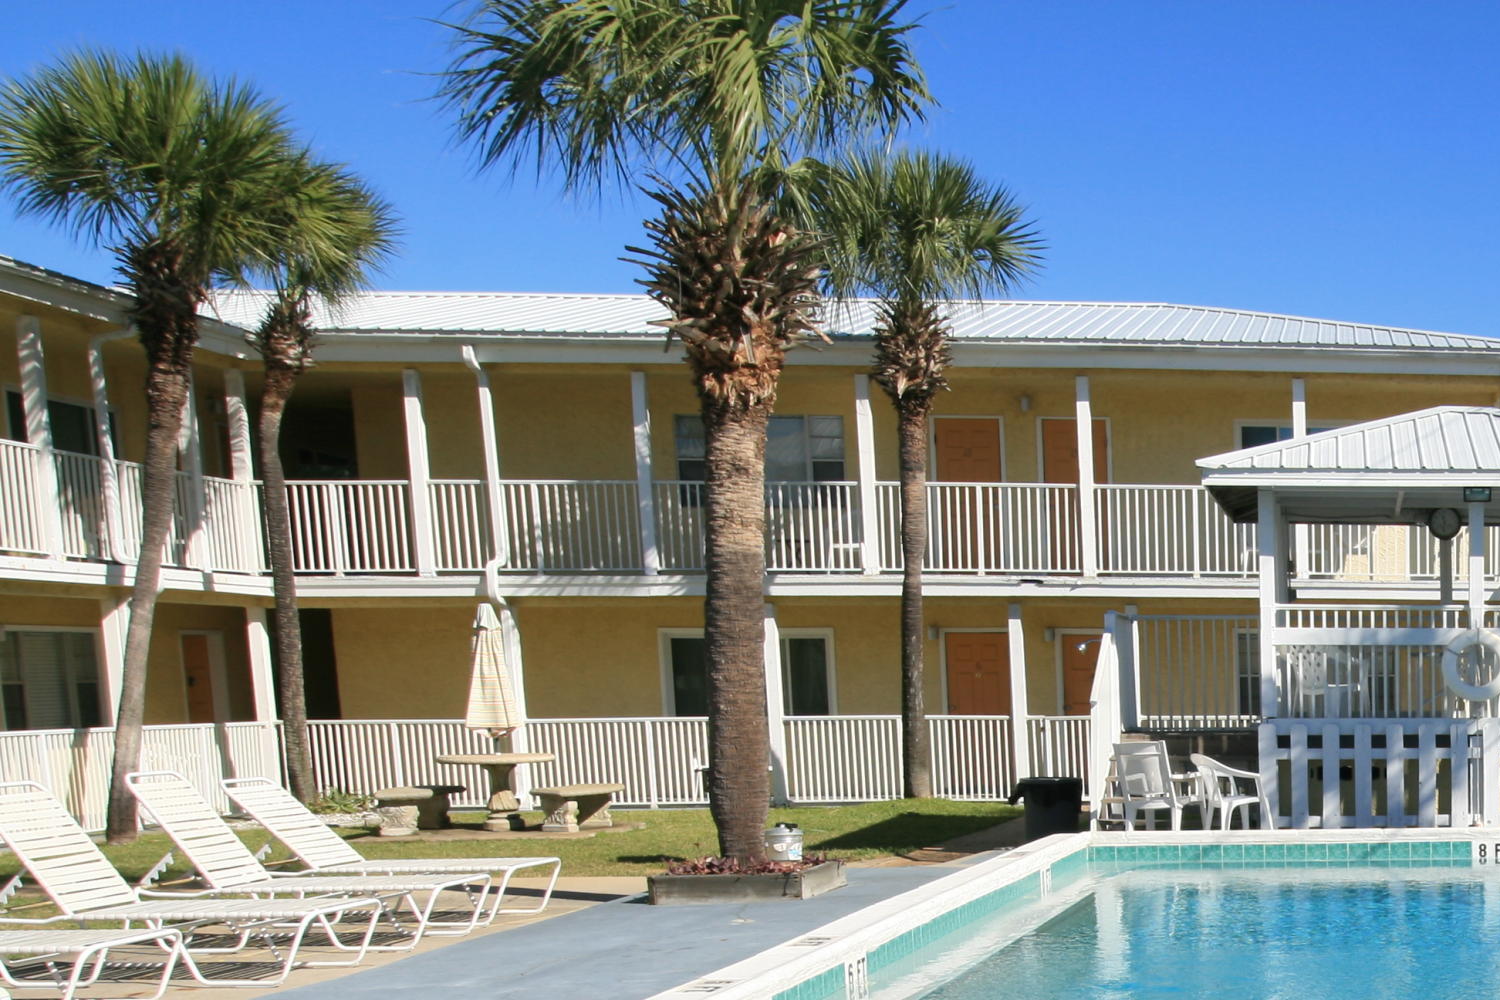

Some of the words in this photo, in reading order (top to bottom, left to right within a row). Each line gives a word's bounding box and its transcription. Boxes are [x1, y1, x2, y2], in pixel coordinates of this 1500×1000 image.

[1478, 843, 1487, 857] 8
[848, 963, 854, 984] 6
[857, 957, 865, 983] FT
